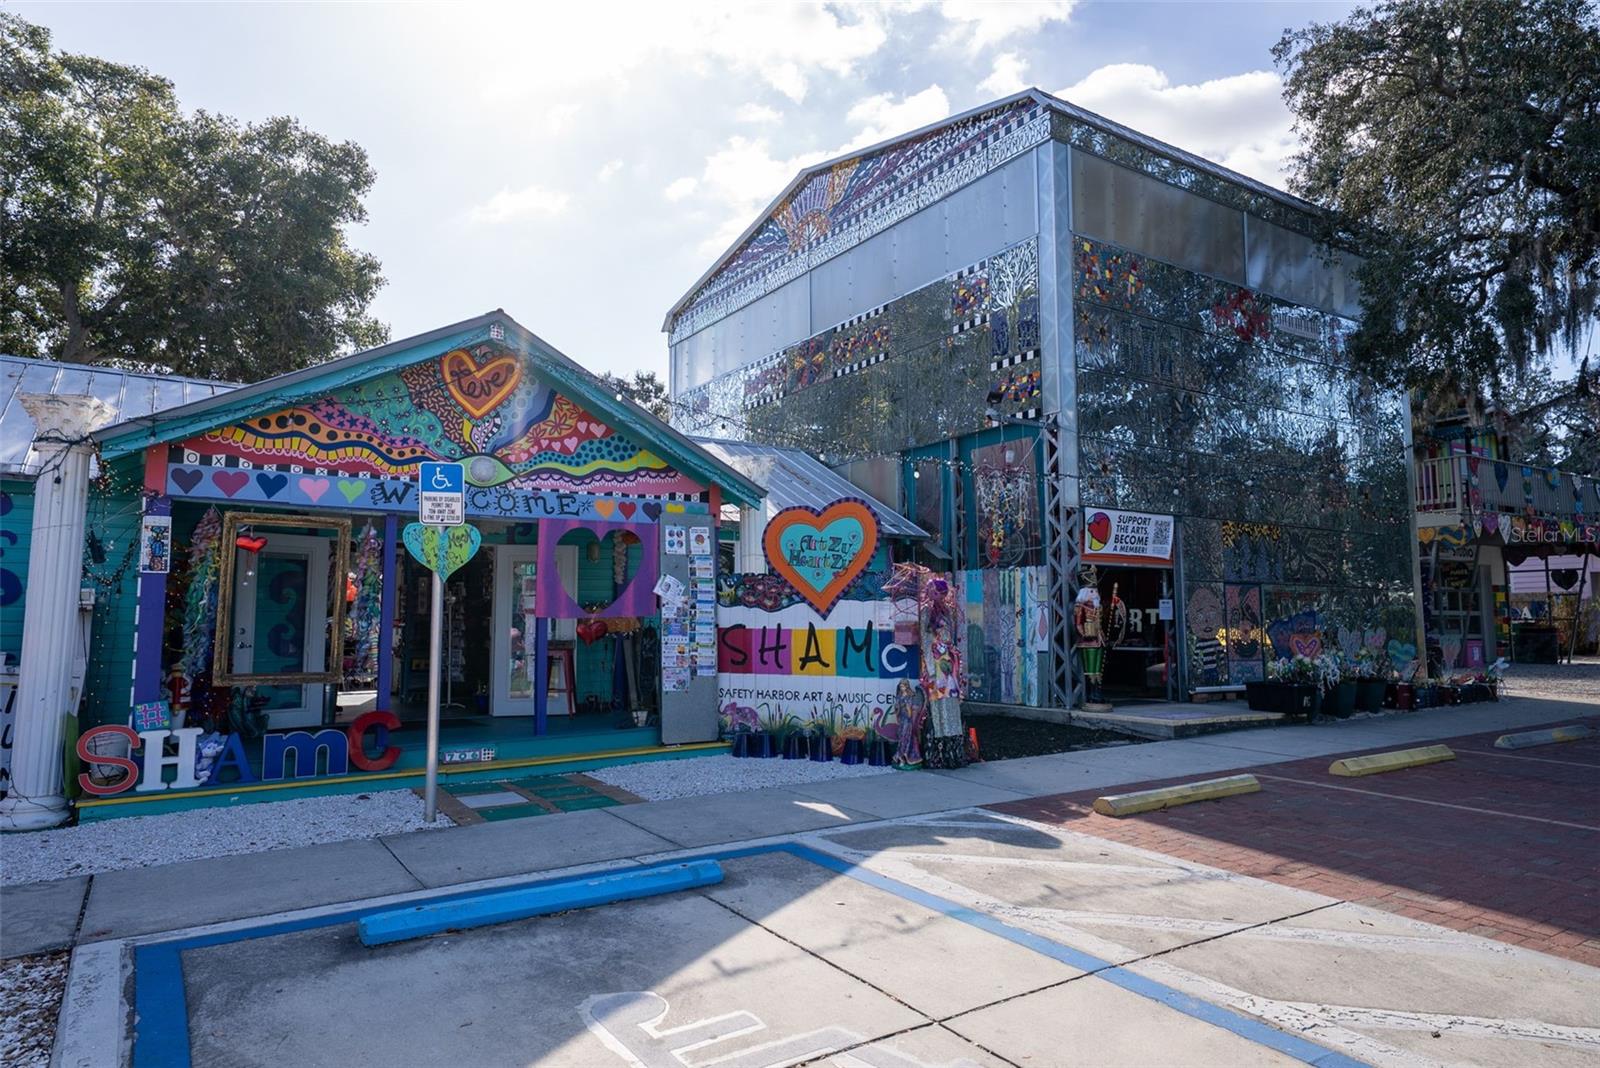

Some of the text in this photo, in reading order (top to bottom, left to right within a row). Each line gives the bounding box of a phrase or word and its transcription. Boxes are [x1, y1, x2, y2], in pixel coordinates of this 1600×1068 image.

[1117, 514, 1151, 526] SUPPORT
[1116, 524, 1129, 532] THE
[1114, 534, 1150, 546] BECOME
[1119, 546, 1148, 554] MEMBER!
[719, 687, 755, 700] SAFETY
[756, 689, 800, 702] HARBOR
[802, 691, 823, 703] ART
[826, 692, 834, 703] &
[837, 692, 873, 704] MUSIC
